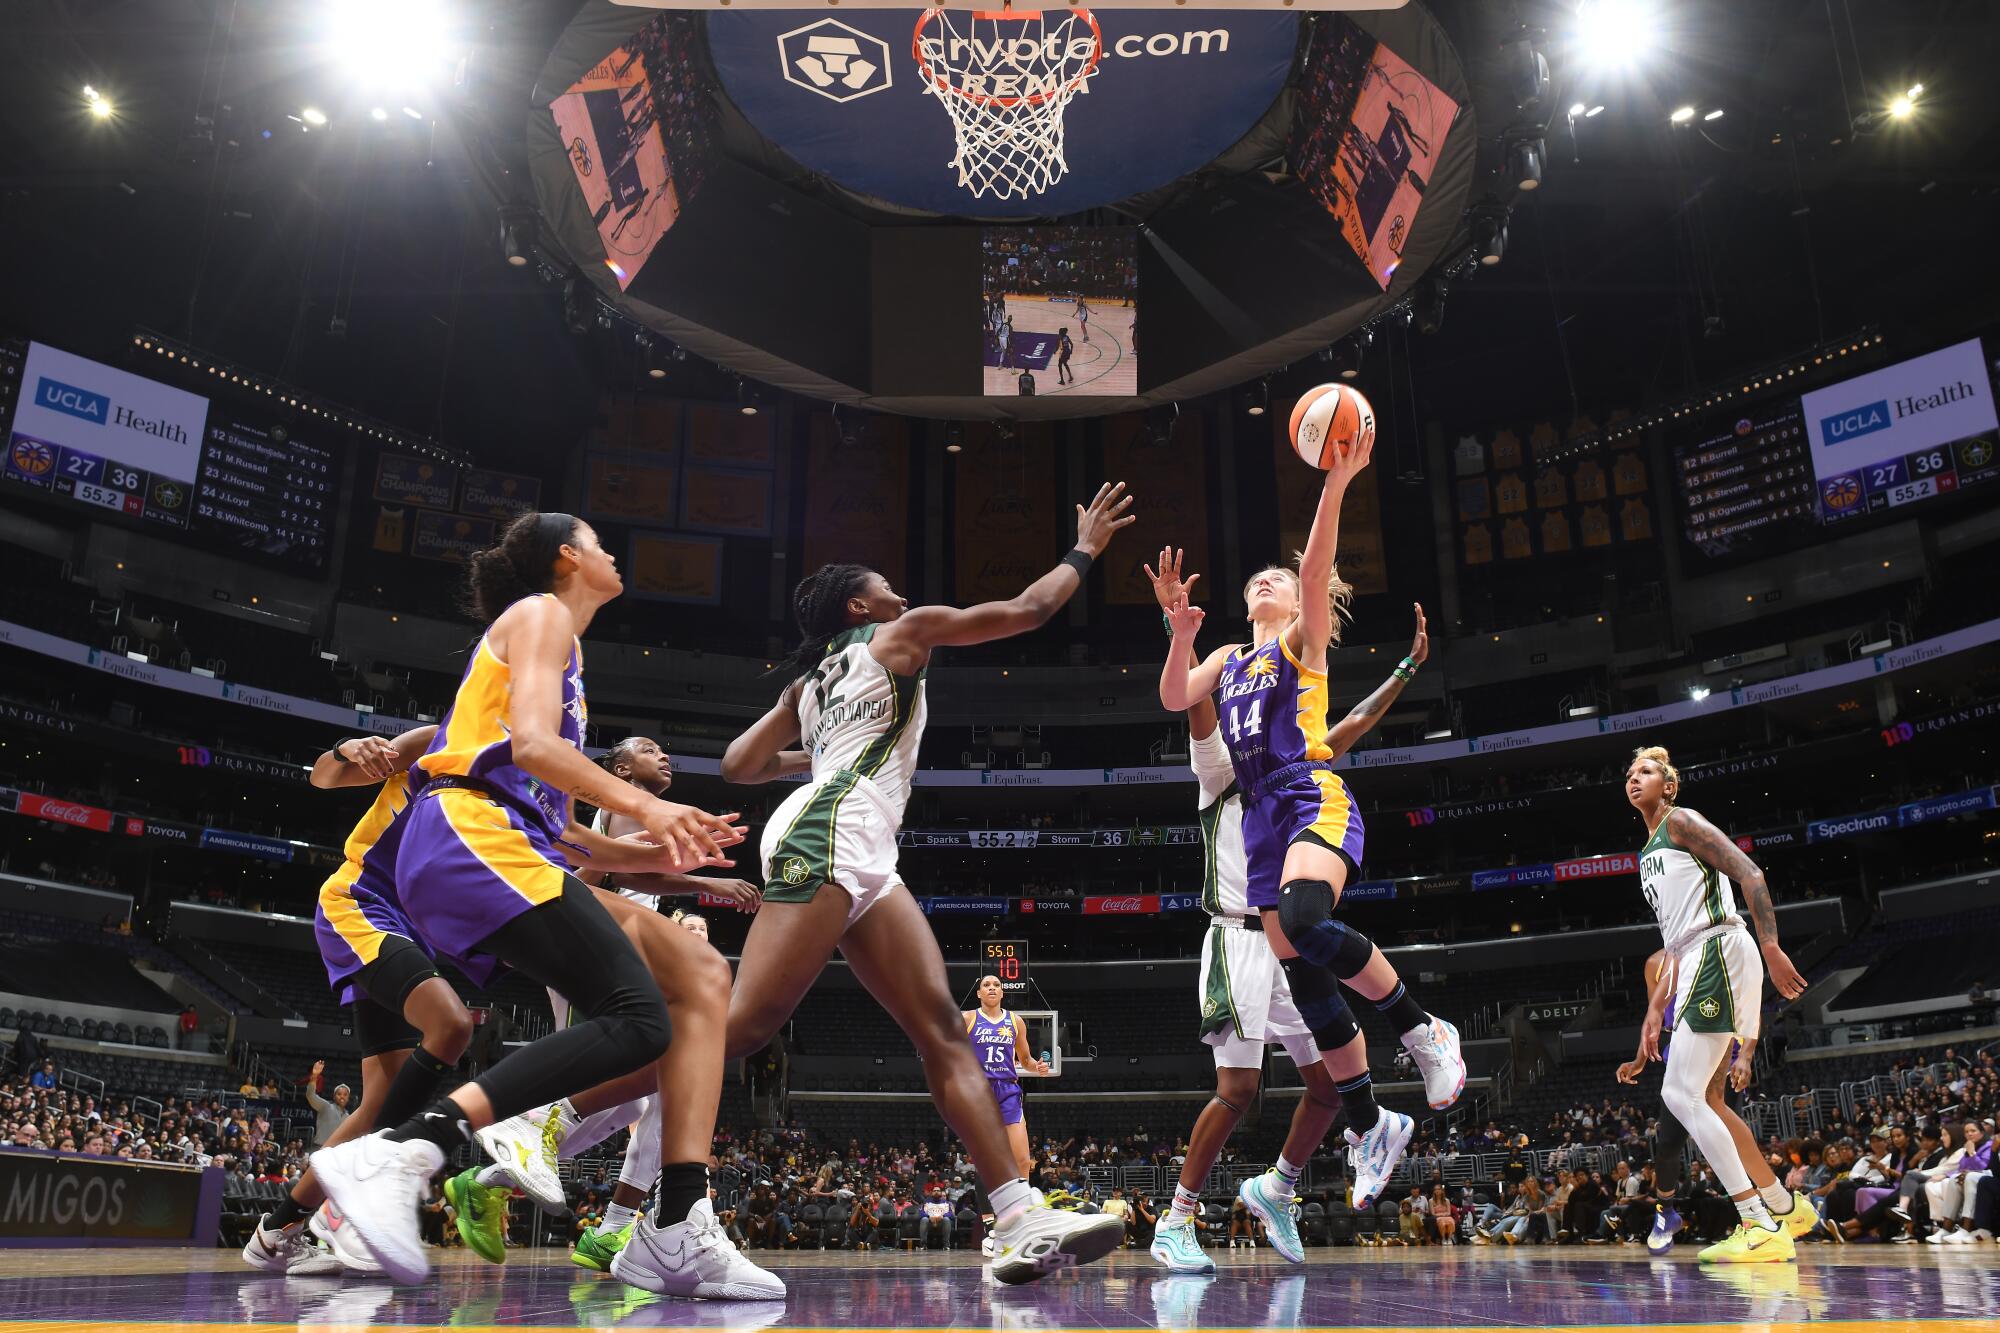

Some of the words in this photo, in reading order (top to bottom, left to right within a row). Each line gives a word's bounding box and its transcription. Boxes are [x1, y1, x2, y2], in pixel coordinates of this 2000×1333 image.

[921, 29, 1229, 66] crypto.com
[922, 74, 1090, 95] ARENA
[47, 386, 98, 416] UCLA
[114, 406, 188, 445] Health
[1830, 410, 1882, 438] UCLA
[1894, 381, 1975, 420] Health
[212, 429, 225, 440] 12
[67, 456, 96, 476] 27
[208, 448, 221, 459] 21
[226, 454, 268, 473] M.Russell
[1684, 458, 1696, 469] 12
[1916, 452, 1943, 474] 36
[112, 468, 138, 489] 36
[205, 467, 219, 478] 23
[1686, 476, 1699, 487] 15
[1704, 464, 1744, 482] J.Thomas
[1873, 464, 1897, 486] 27
[57, 481, 71, 491] 2nd
[82, 486, 117, 506] 55.2
[381, 478, 449, 498] CHAMPIONS
[1688, 495, 1702, 506] 23
[1706, 482, 1749, 501] A.Stevens
[1895, 482, 1930, 502] 55.2
[202, 486, 215, 497] 24
[219, 493, 249, 507] J.Loyd
[466, 492, 532, 511] CHAMPIONS
[200, 505, 213, 516] 32
[216, 511, 269, 532] S.Whitcomb
[276, 528, 286, 536] 14
[1692, 513, 1705, 525] 30
[1709, 497, 1762, 519] N.Ogwumike
[1695, 531, 1708, 542] 44
[1712, 516, 1768, 537] K.Samuelson
[1889, 644, 1944, 669] EquiTrust
[102, 656, 158, 683] EquiTrust
[1220, 674, 1279, 704] ANGELES
[1746, 682, 1801, 703] EquiTrust
[238, 690, 290, 712] EquiTrust
[24, 712, 76, 732] DECAY
[1230, 699, 1262, 744] 44
[1612, 713, 1664, 730] EquiTrust
[1916, 711, 1969, 732] URBAN
[1482, 736, 1530, 752] EquiTrust
[214, 754, 265, 774] URBAN
[271, 766, 310, 780] DECA
[1364, 752, 1414, 766] EquiTrust
[1731, 755, 1780, 774] DECAY
[995, 774, 1041, 786] EquiTrust
[1117, 772, 1164, 784] EquiTrust
[1438, 804, 1484, 819] URBAN
[1488, 798, 1533, 812] DECAY
[1926, 796, 1982, 815] crypto.com
[147, 825, 187, 840] TOYOTA
[1819, 814, 1888, 839] Spectrum
[209, 836, 250, 850] AMERICAN
[251, 842, 286, 855] EXPRESS
[896, 833, 904, 845] 7
[927, 835, 960, 844] Sparks
[978, 832, 1015, 847] 55.2
[1028, 836, 1035, 847] 2
[1051, 835, 1080, 844] Storm
[1103, 832, 1122, 845] 36
[1755, 833, 1793, 846] TOYOTA
[1517, 870, 1550, 880] ULTRA
[1557, 856, 1634, 878] TOSHIBA
[1037, 902, 1070, 910] TOYOTA
[988, 945, 1014, 958] 55.0
[1000, 958, 1018, 979] 10
[977, 1035, 1013, 1045] ANGELES
[985, 1046, 1005, 1062] 15
[281, 1108, 314, 1118] ULTRA
[0, 1170, 126, 1226] MIGOS
